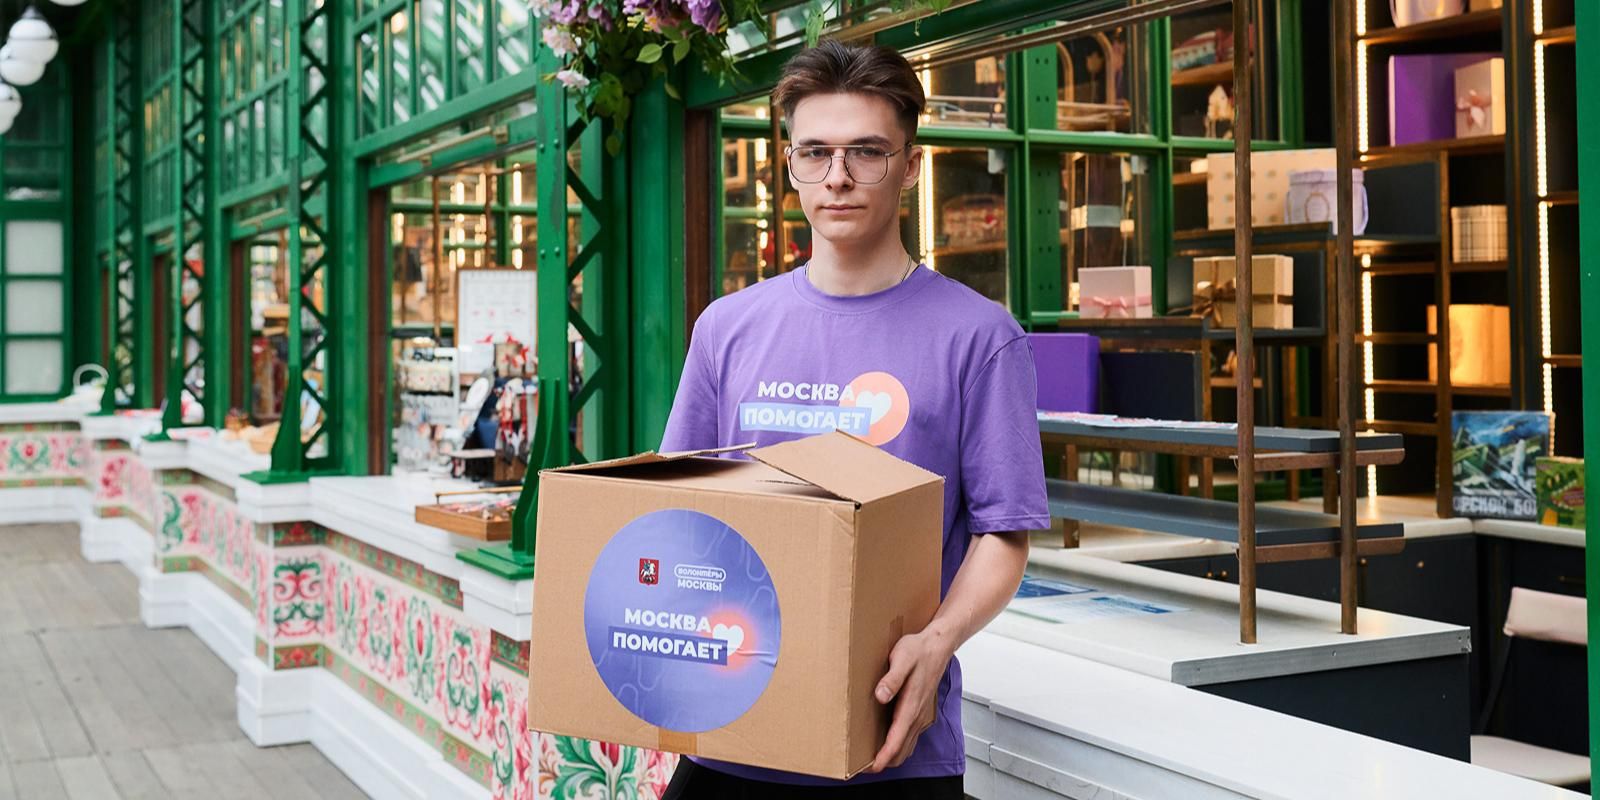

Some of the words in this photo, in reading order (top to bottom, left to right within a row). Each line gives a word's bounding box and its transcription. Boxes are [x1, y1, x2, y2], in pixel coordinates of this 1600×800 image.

[757, 380, 856, 401] МОСКВА
[744, 407, 866, 430] ПОМОГАЕТ
[1453, 495, 1507, 515] ОРСКОЙ
[677, 579, 722, 592] МОСКВЫ
[624, 607, 712, 633] МОСКВА
[613, 632, 723, 660] ПОМОГАЕТ
